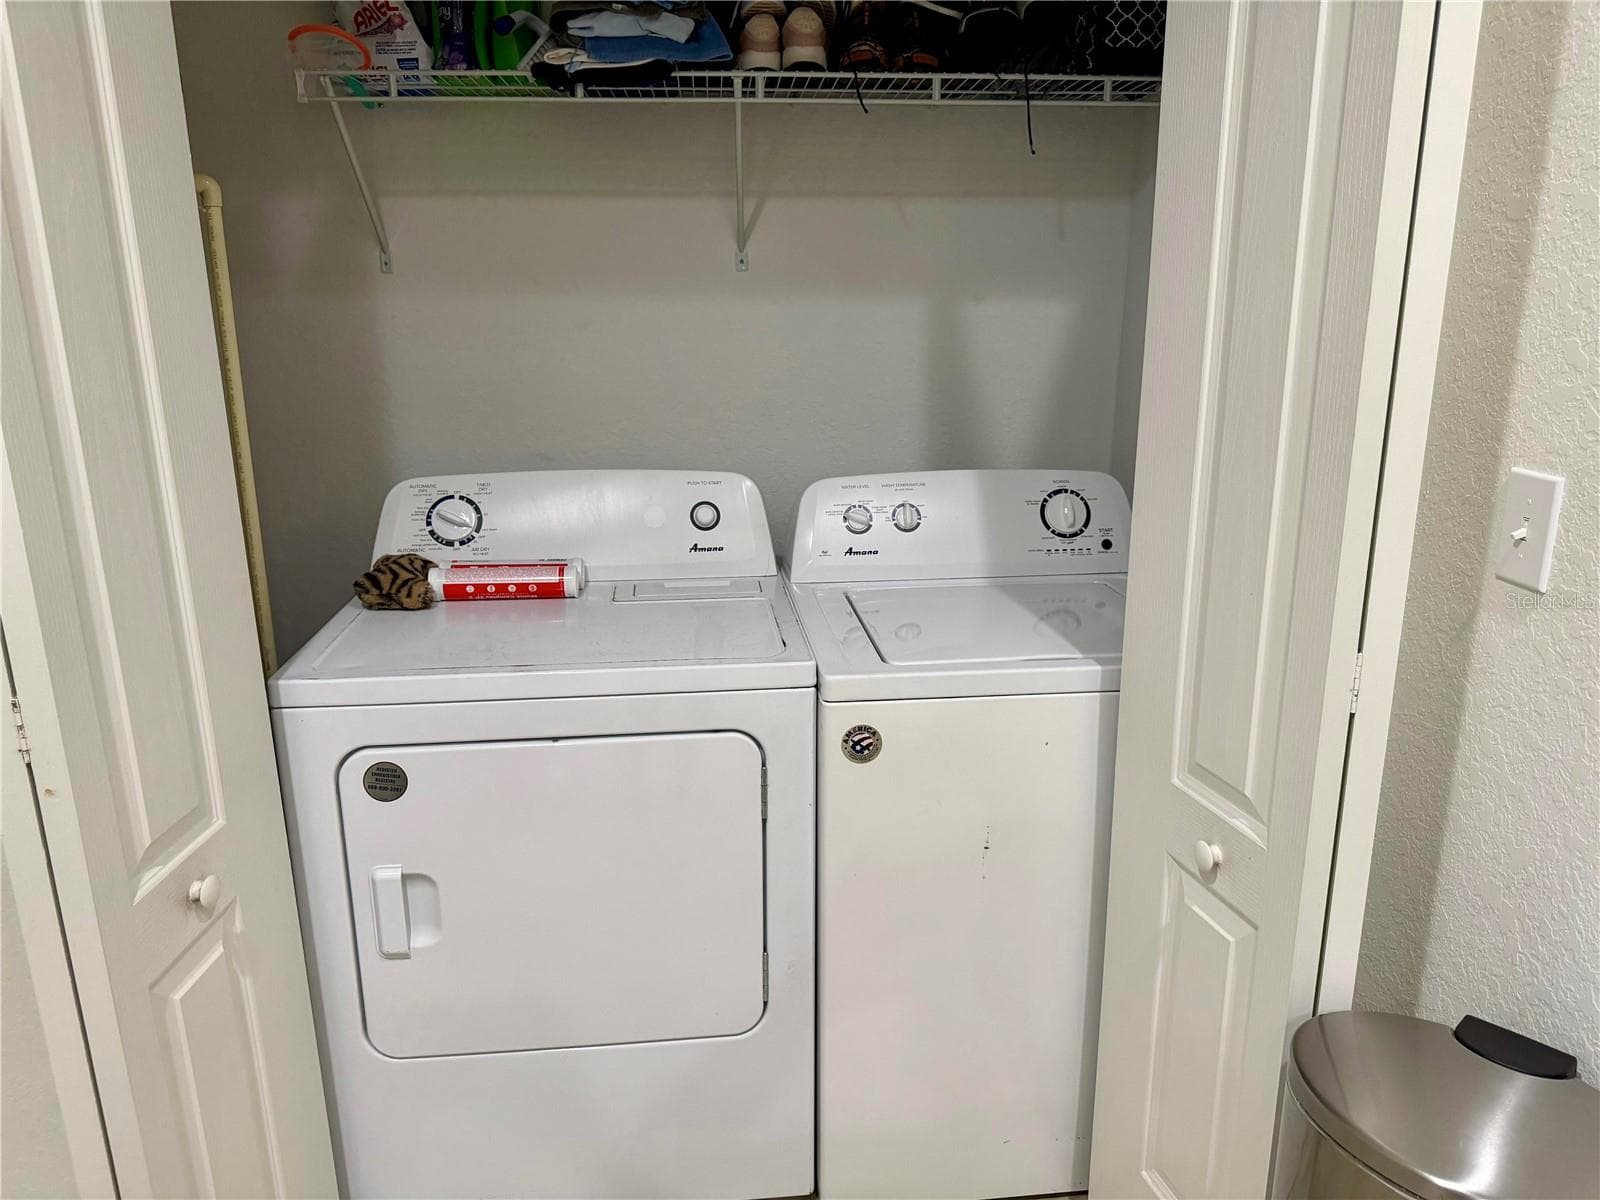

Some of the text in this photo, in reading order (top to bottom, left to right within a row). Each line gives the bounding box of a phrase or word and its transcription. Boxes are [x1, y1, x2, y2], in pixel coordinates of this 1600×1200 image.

[353, 0, 400, 34] ARIEL
[689, 543, 725, 553] Amana
[844, 547, 879, 556] Amana
[842, 725, 878, 745] AMERICA
